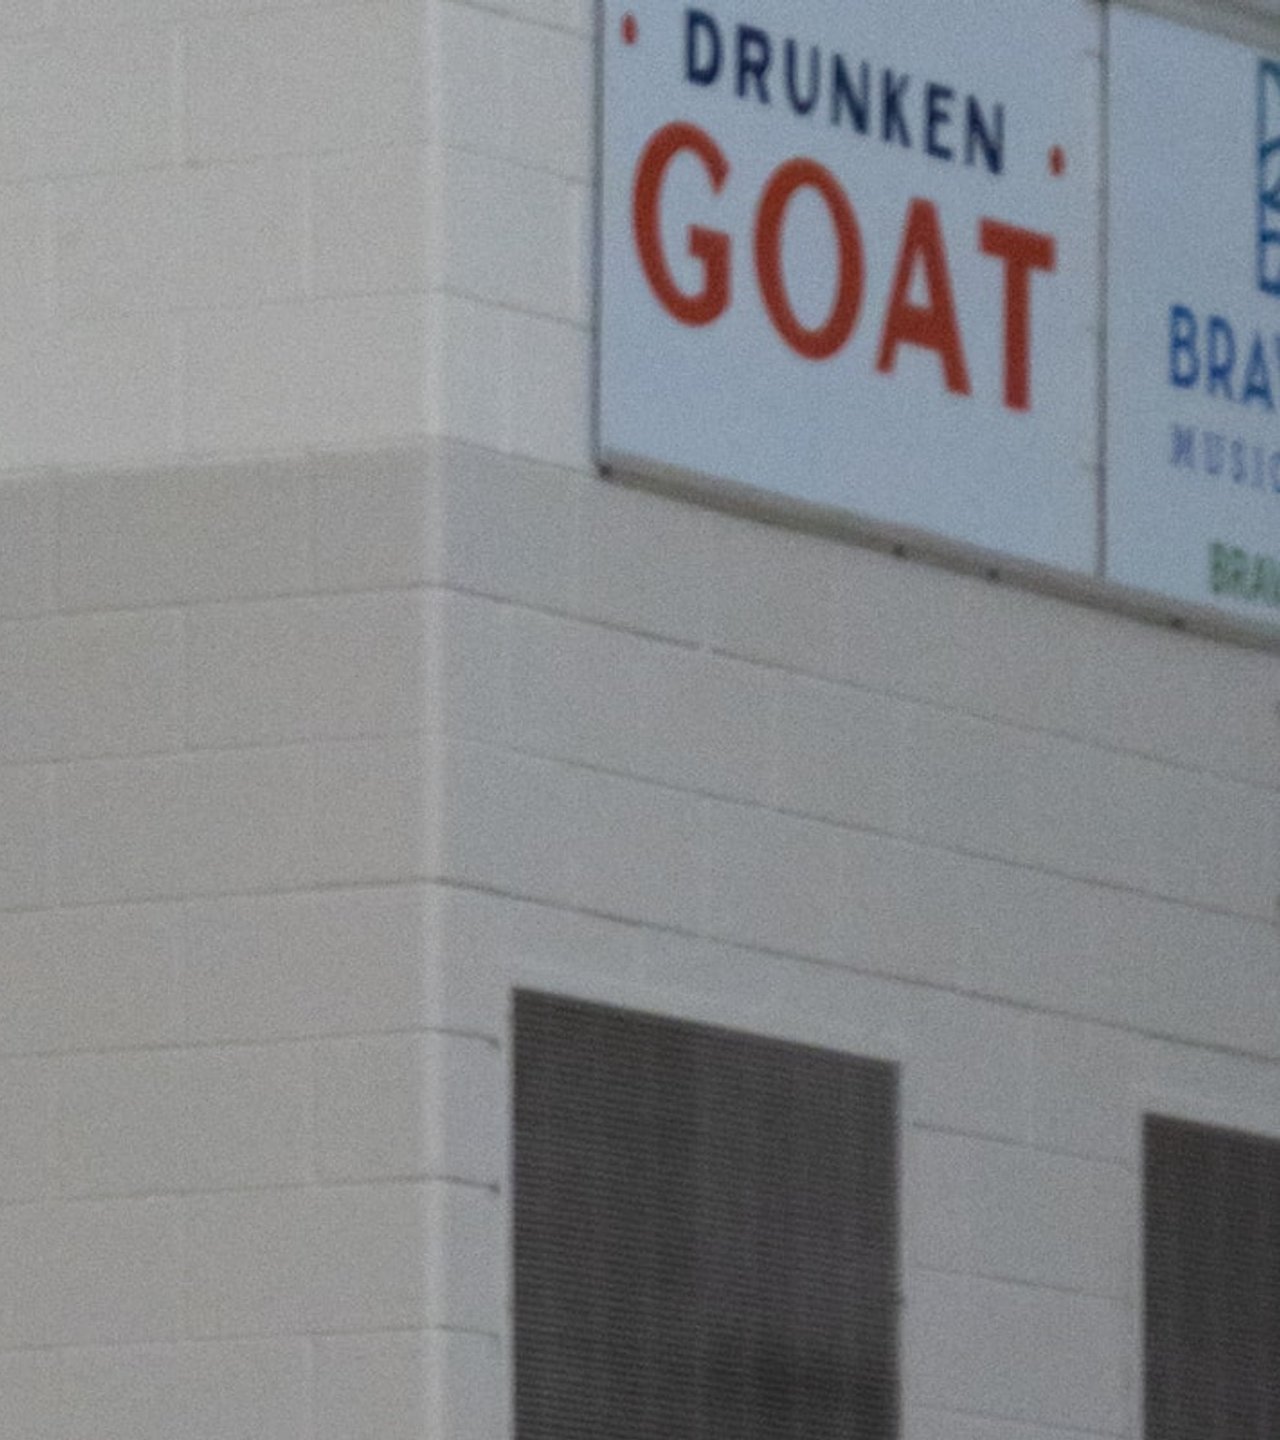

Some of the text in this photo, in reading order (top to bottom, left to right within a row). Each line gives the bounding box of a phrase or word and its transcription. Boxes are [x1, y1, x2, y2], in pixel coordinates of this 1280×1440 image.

[684, 8, 1005, 176] DRUNKEN
[631, 120, 1057, 414] GOAT
[1169, 303, 1280, 408] BRA
